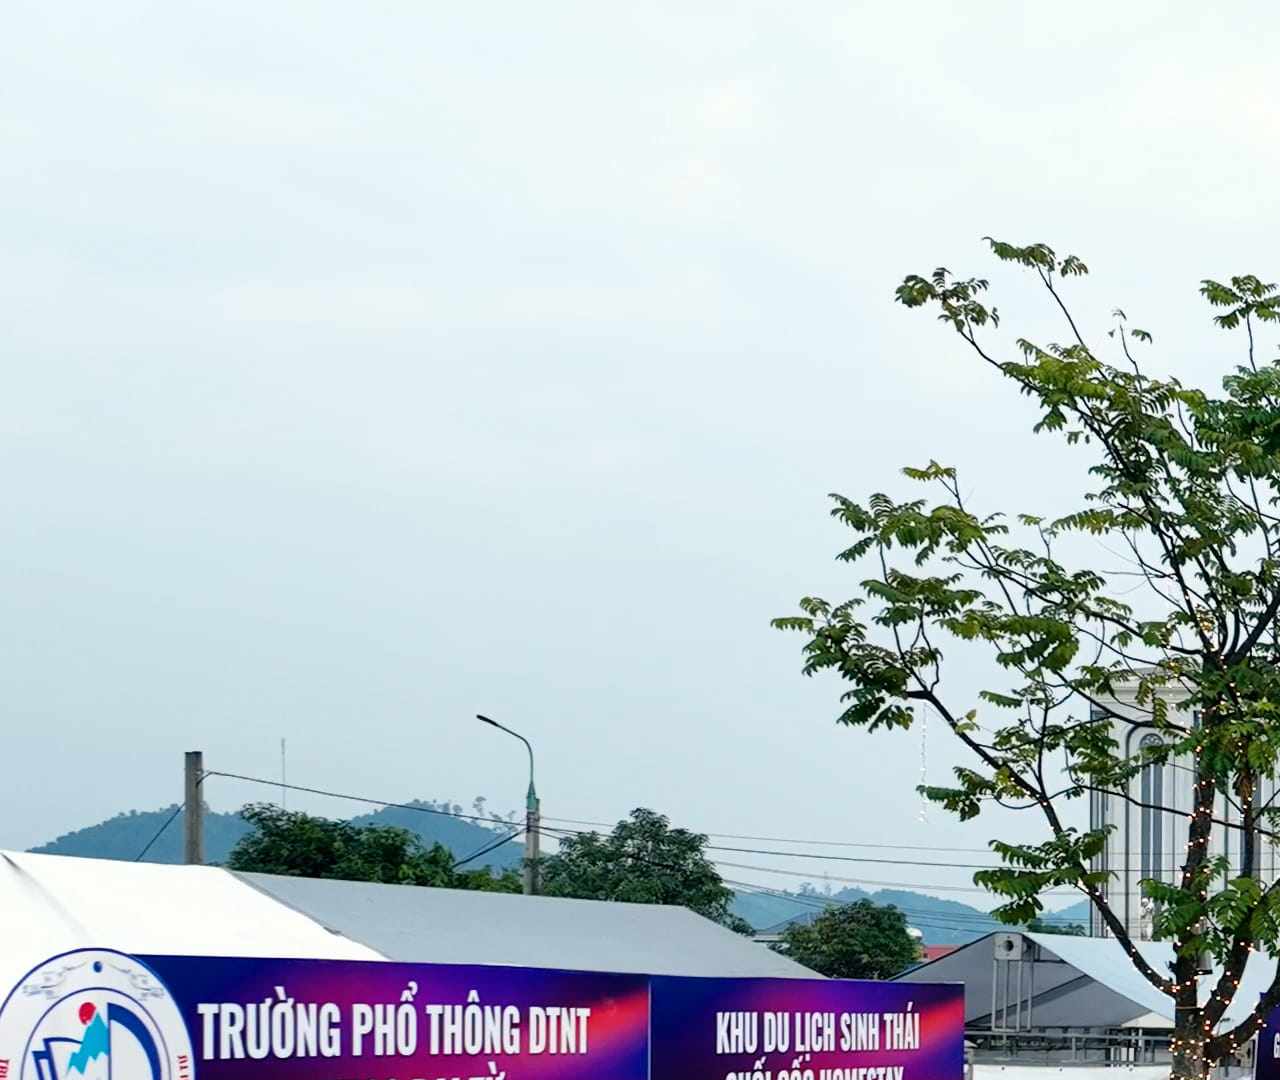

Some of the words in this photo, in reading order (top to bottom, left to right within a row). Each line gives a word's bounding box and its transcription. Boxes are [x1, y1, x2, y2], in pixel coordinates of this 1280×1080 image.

[198, 986, 341, 1060] TRƯỜNG
[352, 981, 418, 1056] PHỔ
[426, 990, 520, 1055] THÔNG
[529, 1007, 591, 1054] DTNT
[716, 1012, 757, 1054] KHU
[764, 1012, 789, 1053] DU
[795, 1012, 835, 1061] LỊCH
[840, 1012, 879, 1052] SINH
[883, 1001, 920, 1050] THÁI
